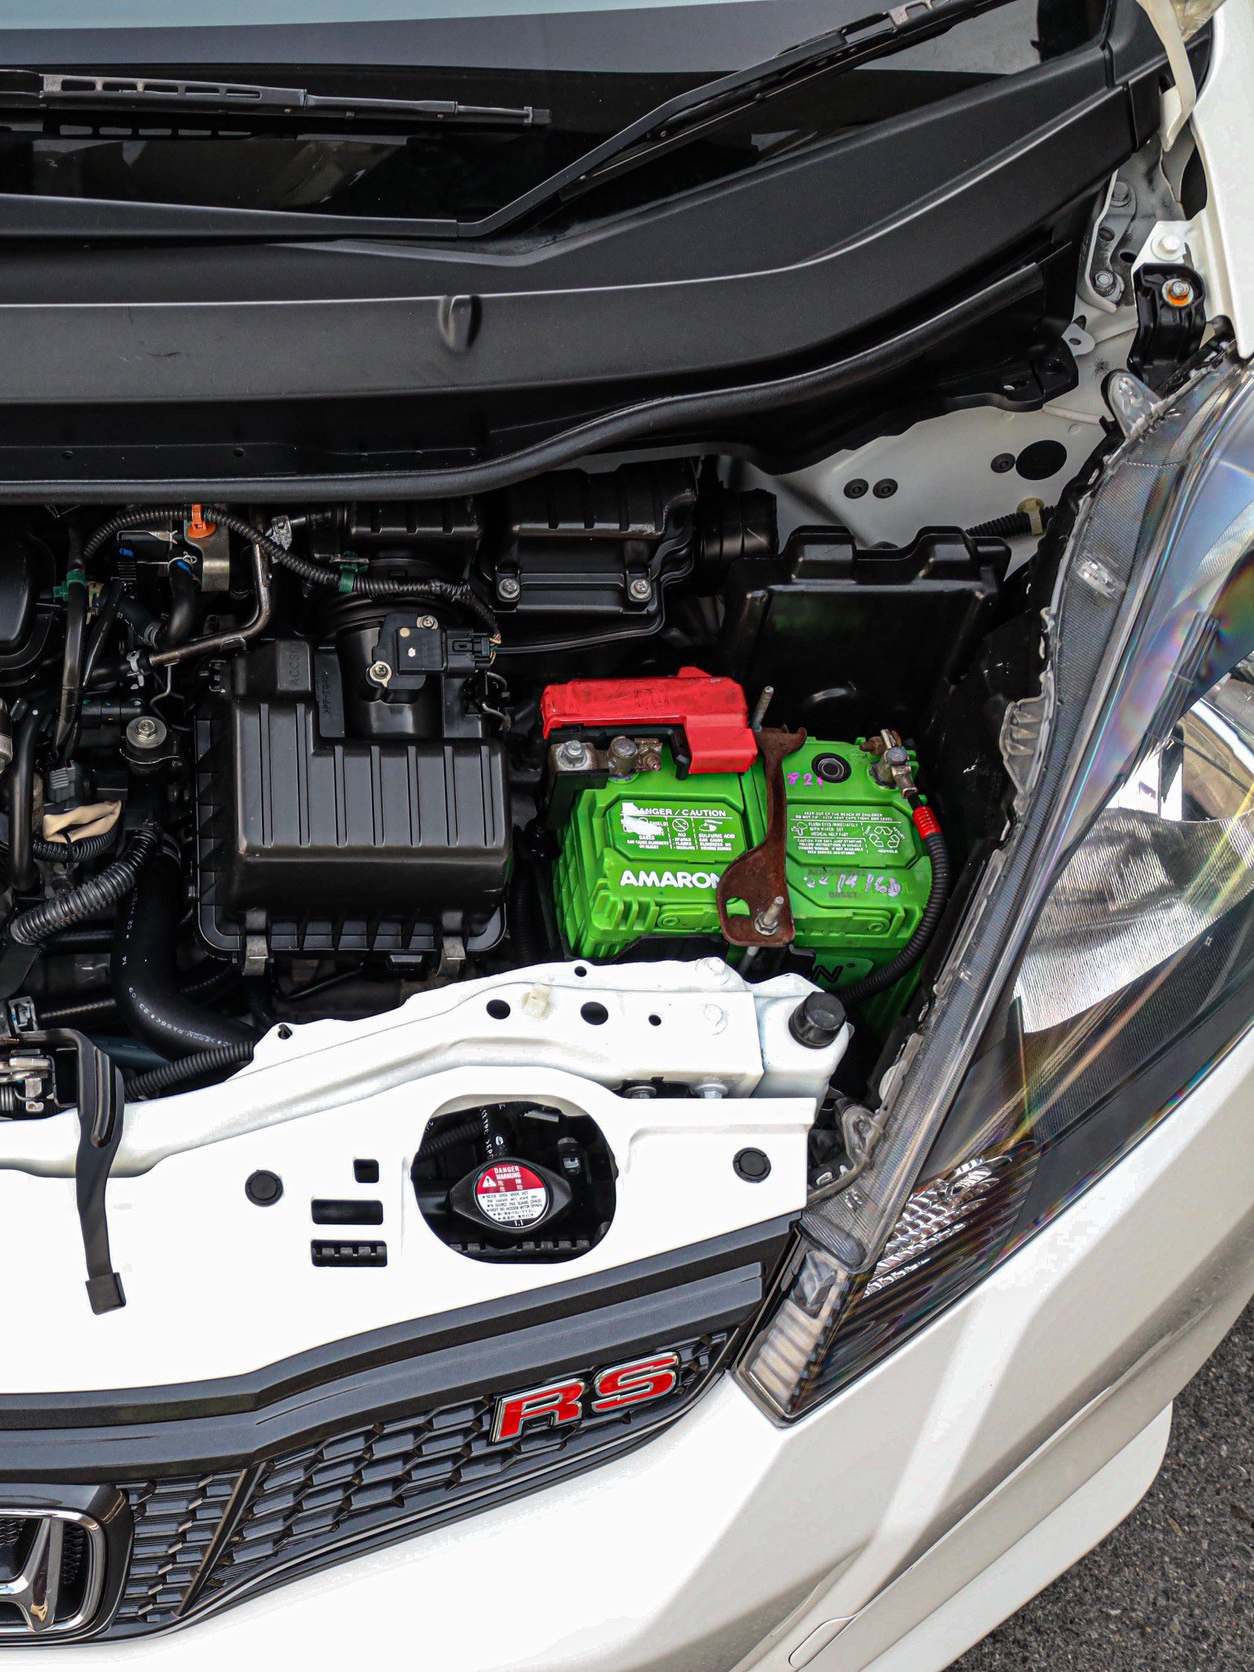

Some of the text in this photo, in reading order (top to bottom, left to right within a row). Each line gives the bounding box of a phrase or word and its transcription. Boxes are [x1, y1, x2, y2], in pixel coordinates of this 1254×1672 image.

[682, 809, 726, 817] CAUTION
[494, 1165, 520, 1174] DANGER
[491, 1351, 681, 1442] RS
